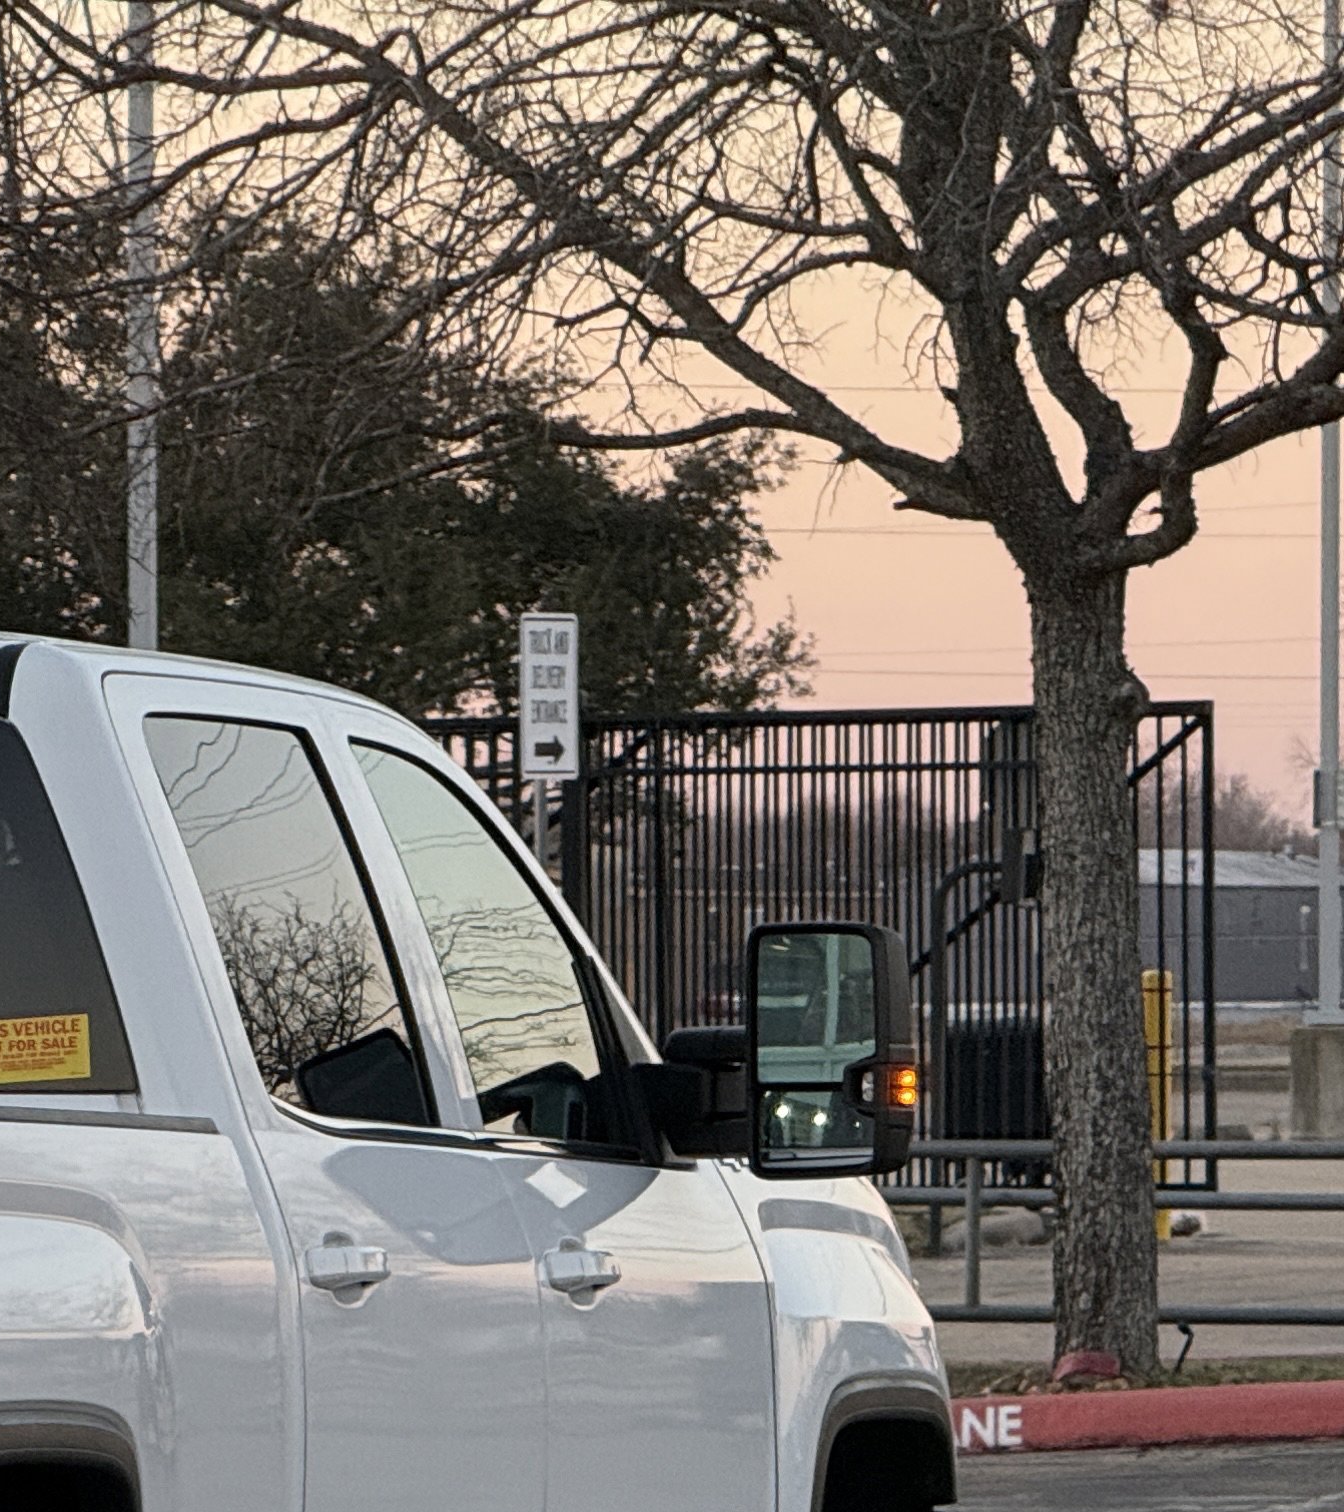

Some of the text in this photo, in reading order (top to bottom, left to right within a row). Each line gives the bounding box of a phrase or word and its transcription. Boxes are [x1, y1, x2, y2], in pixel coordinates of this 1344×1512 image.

[12, 1018, 81, 1037] VEHICLE
[9, 1039, 36, 1052] FOR
[41, 1036, 78, 1049] SALE
[955, 1405, 1022, 1448] NE
